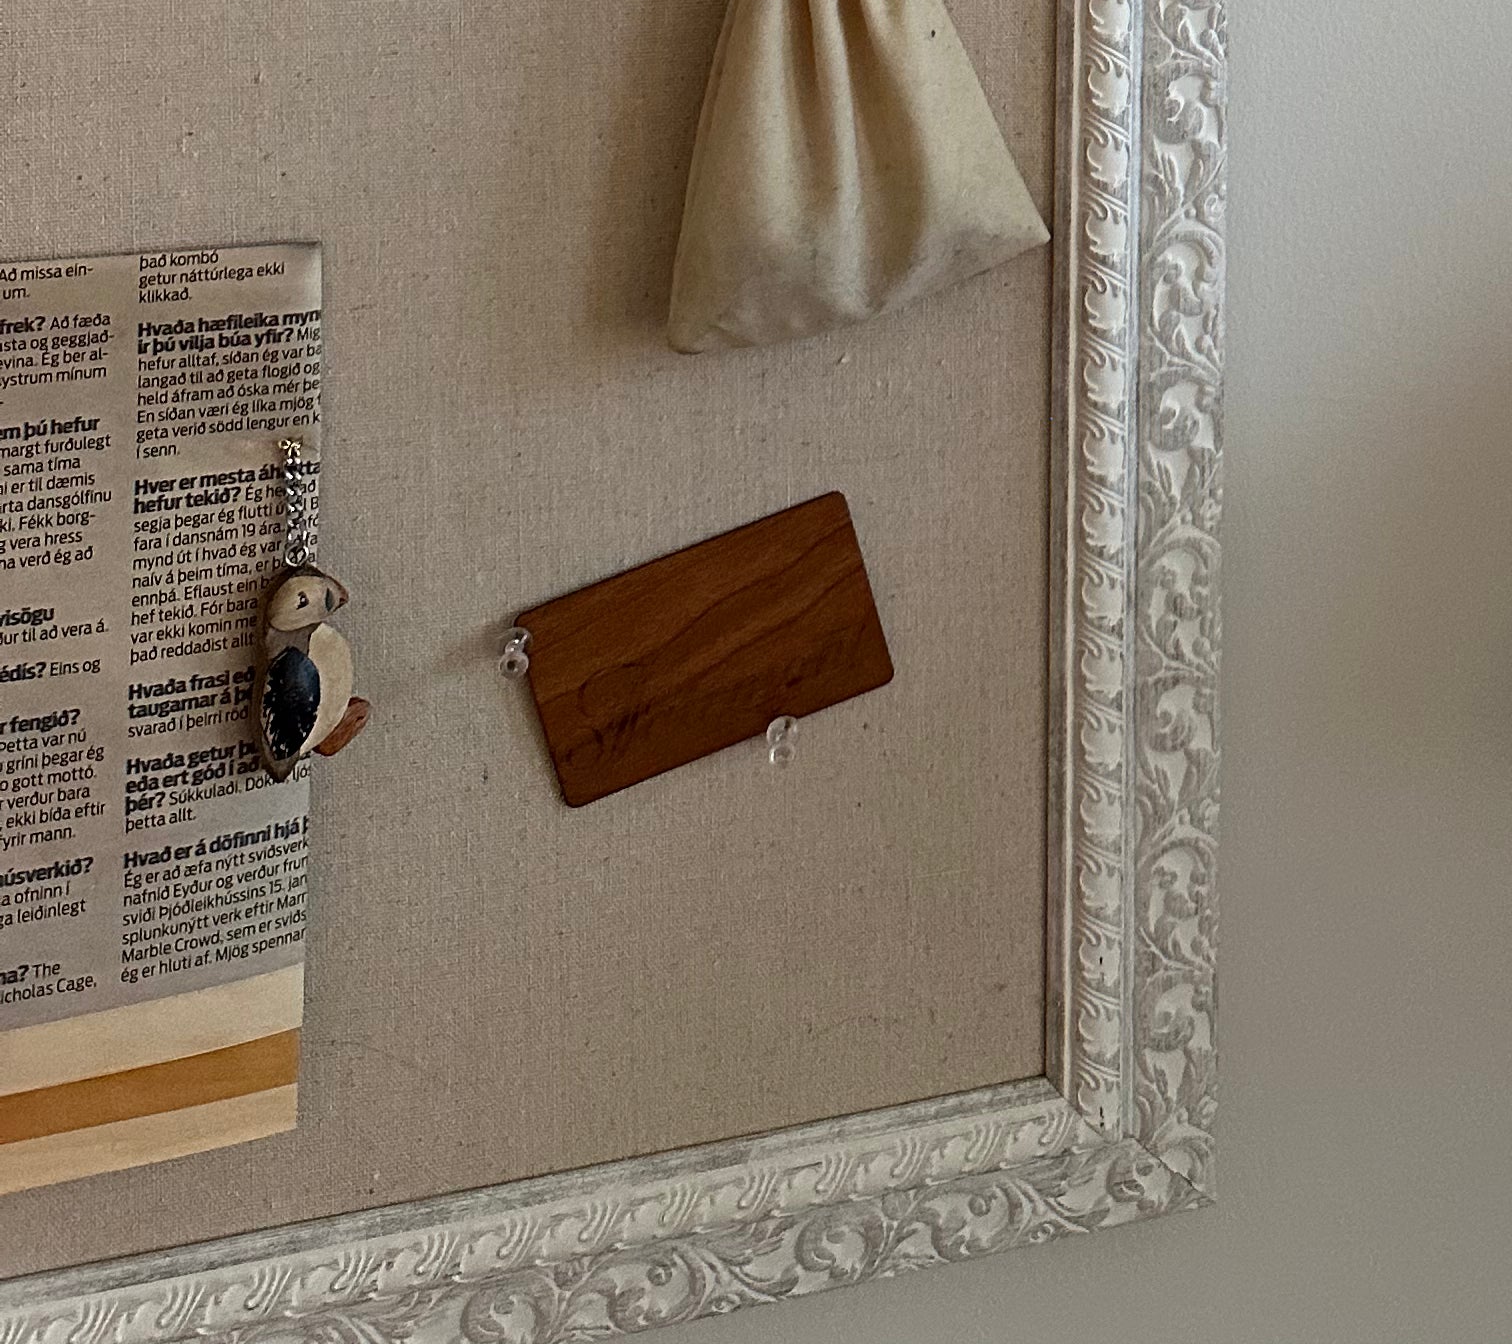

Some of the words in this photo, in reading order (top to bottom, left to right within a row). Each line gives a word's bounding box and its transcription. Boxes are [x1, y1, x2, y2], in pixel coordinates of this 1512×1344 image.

[21, 266, 63, 281] missa
[140, 253, 167, 273] það
[170, 250, 219, 267] kombó
[139, 272, 178, 292] getur
[257, 261, 285, 277] ekki
[49, 316, 70, 331] Að
[71, 313, 111, 329] fæða
[137, 320, 196, 337] Hvaða
[137, 341, 151, 355] ir
[152, 338, 176, 358] þú
[178, 336, 216, 354] vilja
[218, 333, 252, 348] búa
[254, 328, 294, 349] yfir?
[297, 327, 320, 344] Mig
[138, 356, 177, 372] hefur
[221, 349, 259, 364] síðan
[260, 347, 280, 365] ég
[281, 347, 304, 359] var
[138, 371, 187, 392] langað
[188, 370, 203, 385] til
[206, 368, 225, 383] að
[227, 367, 259, 386] geta
[260, 362, 301, 382] flogið
[303, 363, 320, 379] og
[23, 422, 48, 442] þú
[50, 419, 100, 435] hefur
[134, 480, 177, 495] Hver
[178, 477, 198, 489] er
[199, 469, 256, 487] mesta
[133, 496, 184, 513] hefur
[184, 488, 242, 507] tekið?
[245, 484, 263, 504] Ég
[19, 513, 53, 529] Fékk
[134, 517, 171, 534] segja
[174, 511, 216, 531] þegar
[218, 507, 235, 525] ég
[238, 502, 274, 519] flutti
[130, 644, 158, 665] það
[231, 634, 259, 650] allt
[50, 663, 80, 677] Eins
[82, 662, 101, 678] og
[41, 735, 66, 748] var
[68, 729, 87, 744] nú
[6, 756, 38, 777] gríni
[41, 753, 83, 773] þegar
[86, 748, 104, 765] ég
[11, 774, 46, 795] gott
[124, 792, 166, 816] þér?
[125, 814, 166, 834] þetta
[124, 870, 143, 889] Ég
[145, 870, 160, 882] er
[162, 862, 181, 879] að
[184, 857, 212, 874] æfa
[215, 850, 246, 870] nýtt
[121, 940, 172, 962] Marble
[222, 923, 256, 939] sem
[259, 918, 273, 931] er
[35, 964, 61, 980] The
[121, 965, 139, 982] ég
[141, 962, 156, 975] er
[159, 952, 192, 971] hluti
[215, 941, 250, 962] Mjög
